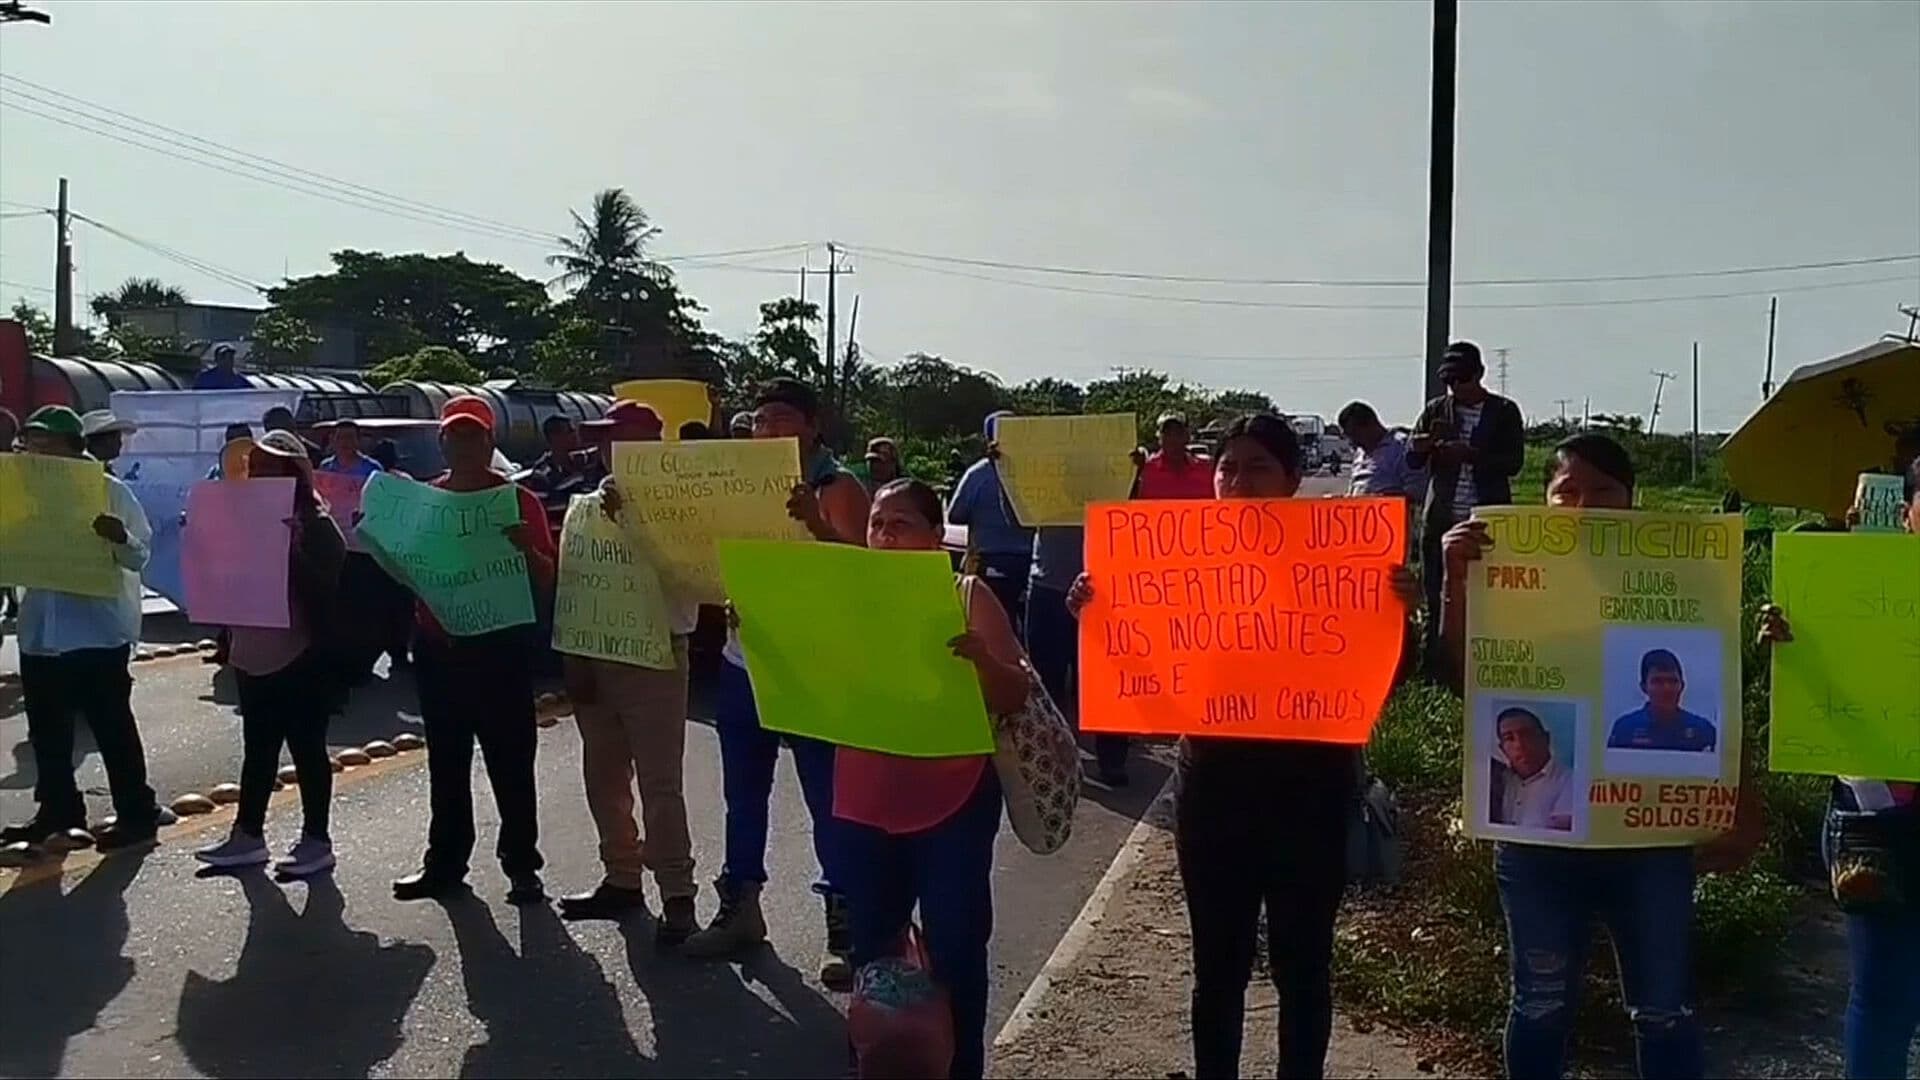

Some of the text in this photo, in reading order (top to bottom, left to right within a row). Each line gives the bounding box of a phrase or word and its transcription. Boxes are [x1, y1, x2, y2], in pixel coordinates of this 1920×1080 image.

[644, 480, 714, 502] PEDIMOS
[724, 477, 756, 496] NOS
[383, 494, 490, 538] JUICIA
[1106, 500, 1394, 560] PROCESOS JUSTOS
[1477, 512, 1731, 561] JUSTICIA
[1111, 562, 1381, 612] LIBERTAD PARA
[1486, 564, 1548, 591] PARA:
[1620, 569, 1678, 594] LUIS
[593, 595, 637, 629] LUIS
[1599, 595, 1702, 622] ENRIQUE
[1105, 603, 1346, 657] LOS INOCENTES
[1471, 636, 1534, 664] JUAN
[1172, 662, 1189, 695] E
[1475, 665, 1567, 690] CARLOS
[1200, 686, 1366, 726] JUAN CARLOS
[1657, 777, 1737, 807] ESTÁN
[1622, 806, 1737, 832] SOLOS!!!
